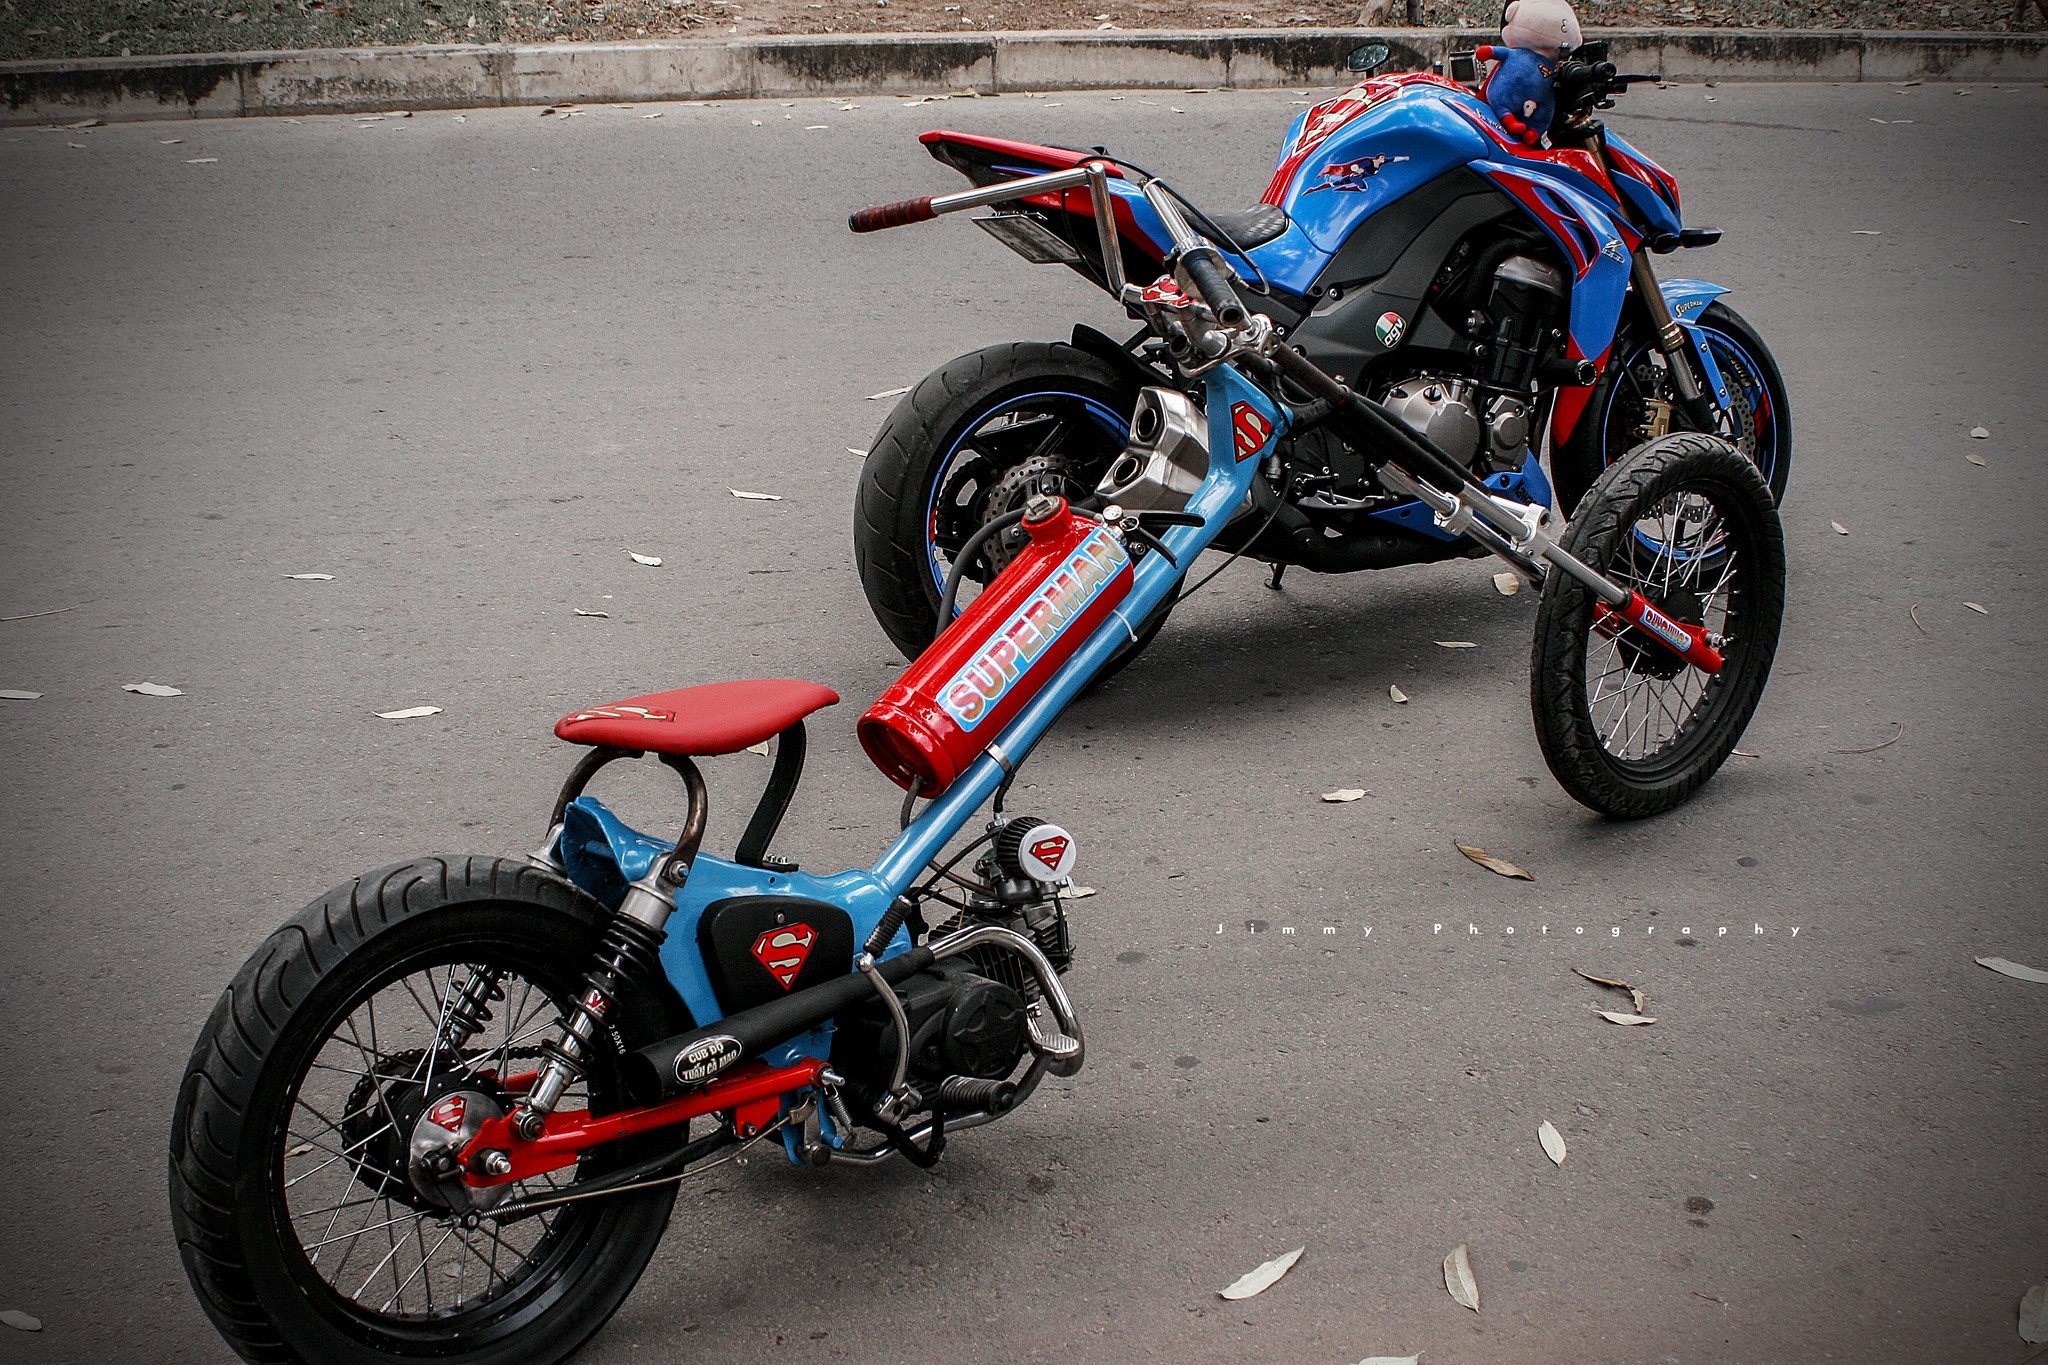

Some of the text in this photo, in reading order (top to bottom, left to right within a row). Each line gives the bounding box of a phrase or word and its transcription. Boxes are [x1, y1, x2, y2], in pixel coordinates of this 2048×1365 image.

[1384, 317, 1403, 346] agv
[1230, 401, 1272, 464] S
[947, 529, 1129, 723] SUPERMAN
[1029, 835, 1069, 871] S
[750, 922, 818, 991] S
[688, 1048, 709, 1064] CUB
[427, 1095, 467, 1134] S
